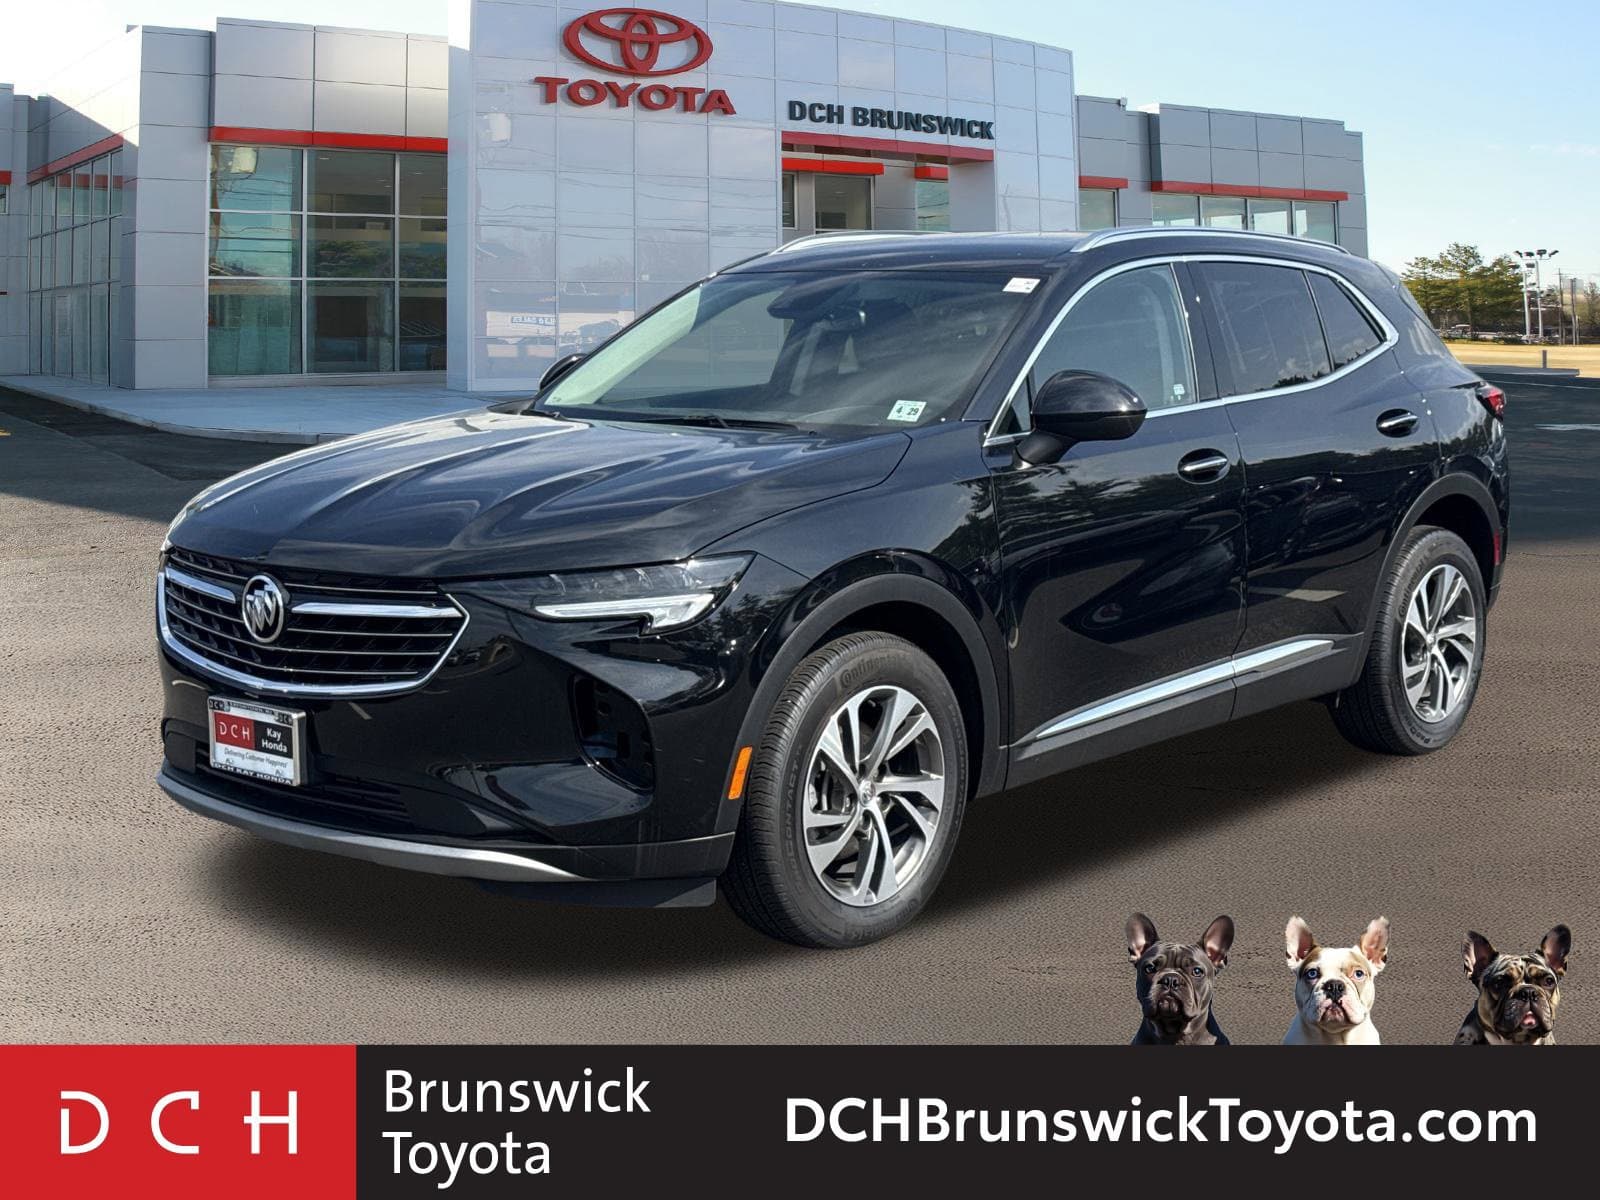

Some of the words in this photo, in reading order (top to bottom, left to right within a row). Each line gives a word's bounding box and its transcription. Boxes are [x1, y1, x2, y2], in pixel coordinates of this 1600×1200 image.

[534, 76, 736, 116] TOYOTA
[788, 99, 845, 126] DCH
[852, 105, 995, 140] BRUNSWICK
[219, 721, 250, 741] DCH
[266, 727, 281, 741] Kay
[261, 739, 288, 753] Honda
